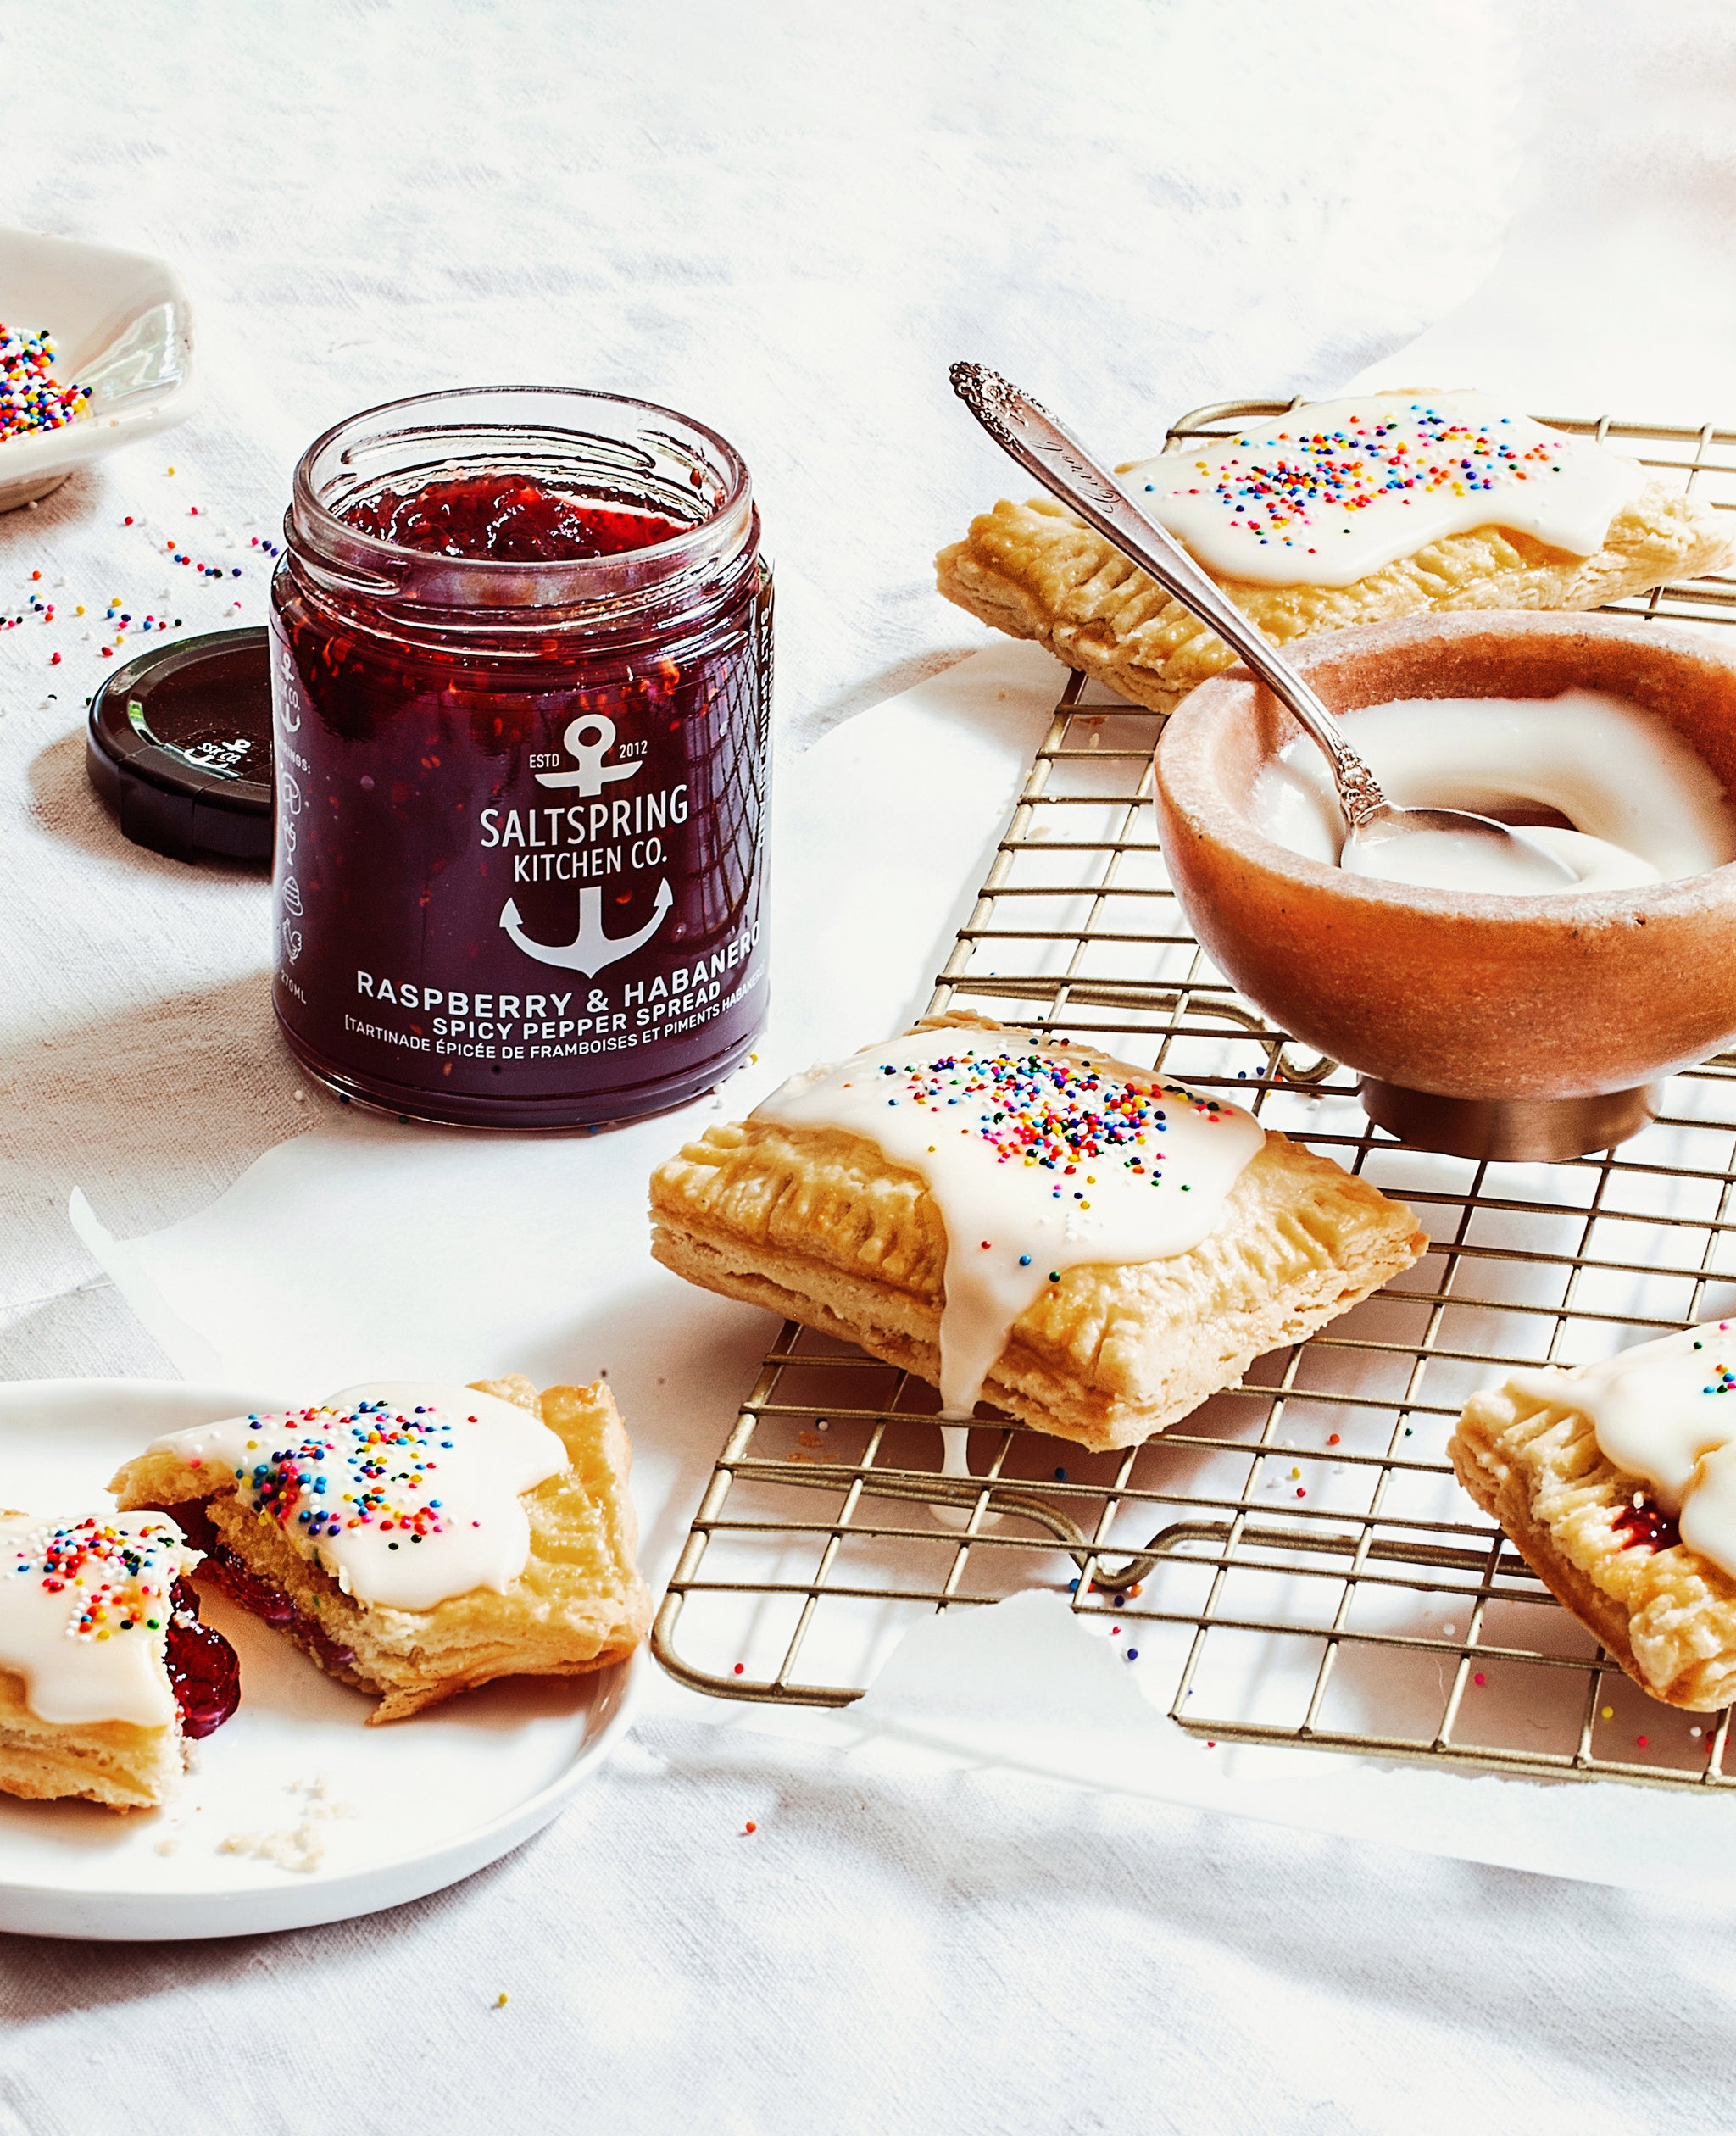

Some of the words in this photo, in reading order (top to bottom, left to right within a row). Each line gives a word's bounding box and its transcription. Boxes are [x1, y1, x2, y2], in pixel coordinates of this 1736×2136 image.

[760, 670, 769, 758] SPRING
[529, 753, 559, 769] ESTD
[619, 739, 648, 759] 2012
[480, 784, 688, 848] SALTSPRING
[514, 845, 621, 882] KITCHEN
[631, 837, 668, 870] CO.
[357, 970, 573, 1019] RASPBERRY
[586, 988, 609, 1014] &
[624, 920, 760, 1008] HABANERO
[432, 1016, 514, 1041] SPICY
[523, 1013, 627, 1041] PEPPER
[636, 981, 721, 1026] SPREAD
[435, 1038, 497, 1059] ÉPICÉE
[501, 1045, 525, 1060] DE
[530, 1033, 638, 1060] FRAMBOISES
[642, 1026, 661, 1044] ET
[664, 1004, 721, 1037] PIMENTS
